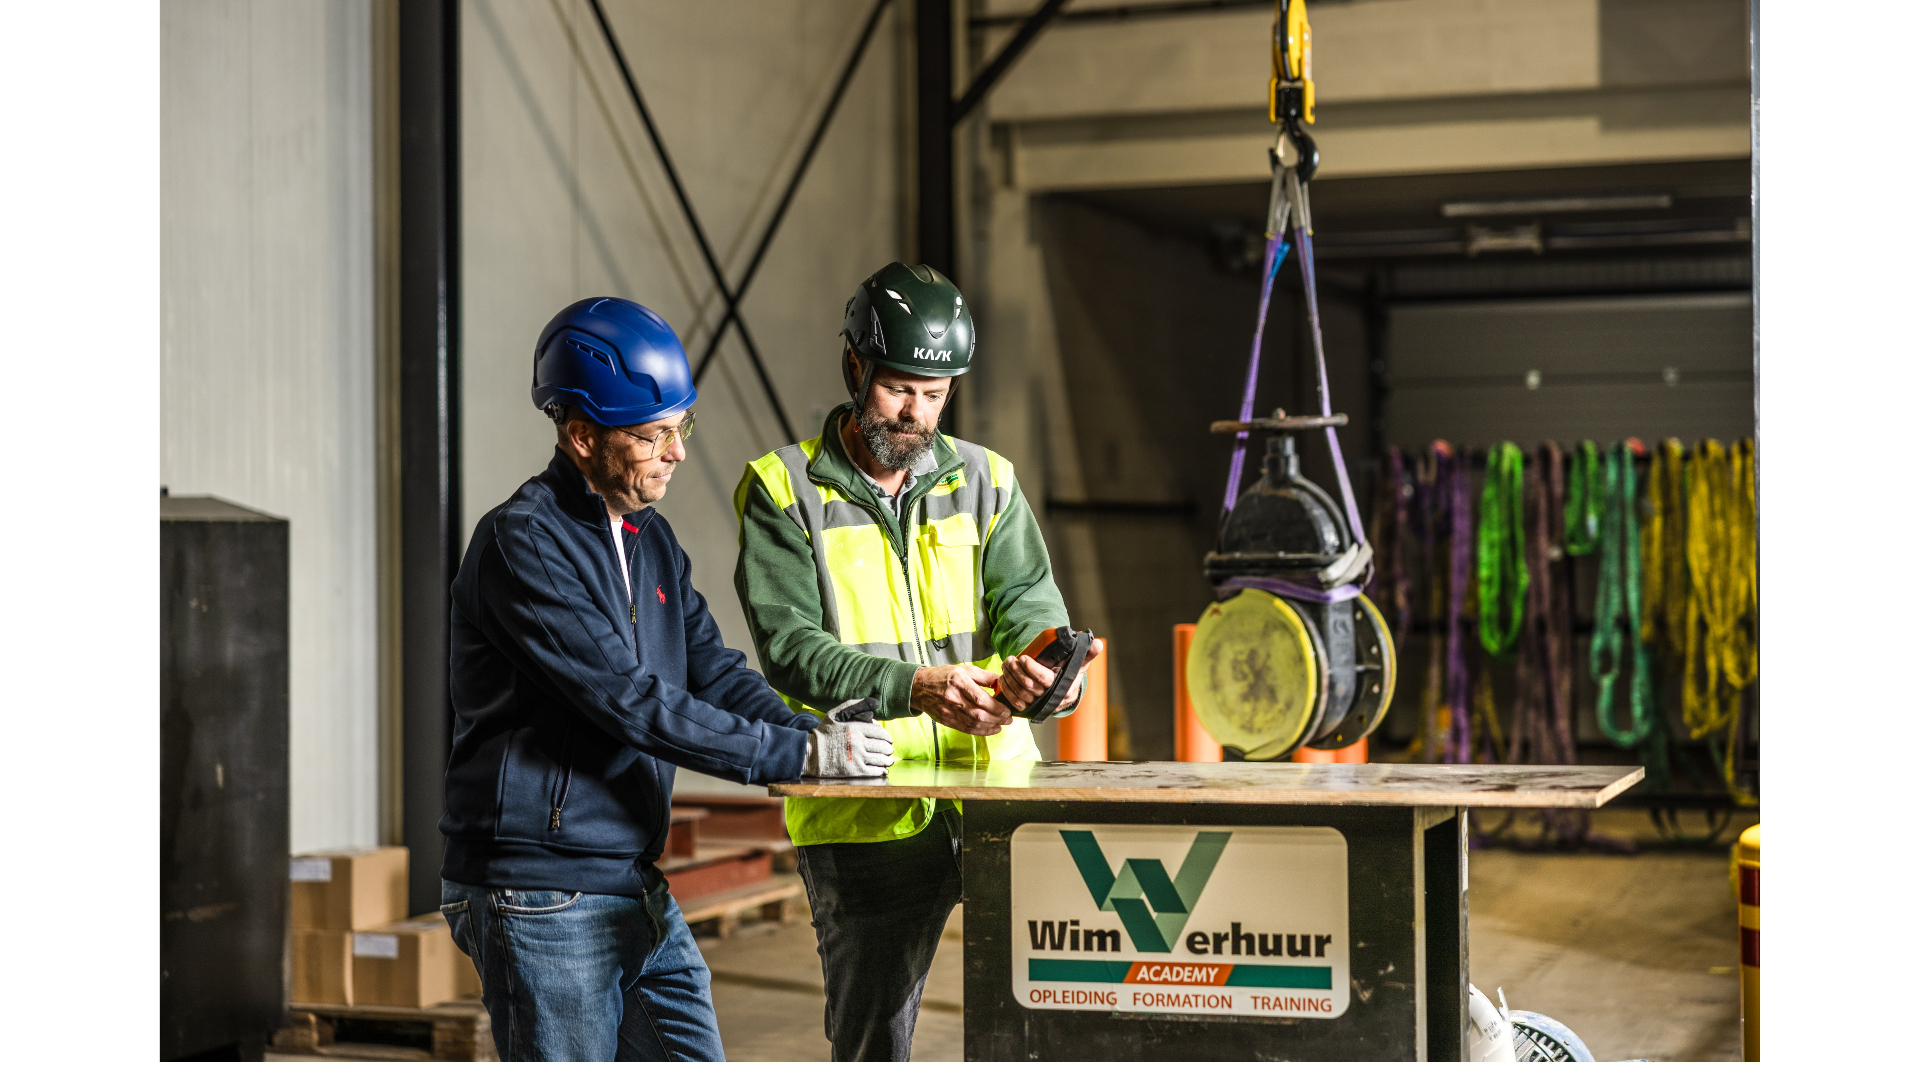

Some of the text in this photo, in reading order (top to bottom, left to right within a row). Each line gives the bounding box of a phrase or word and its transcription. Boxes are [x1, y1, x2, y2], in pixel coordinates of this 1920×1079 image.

[914, 347, 952, 362] KASK
[1027, 919, 1122, 952] Wim
[1136, 965, 1219, 984] ACADEMY
[1029, 989, 1333, 1013] OPLEIDING FORMATION TRAINING
